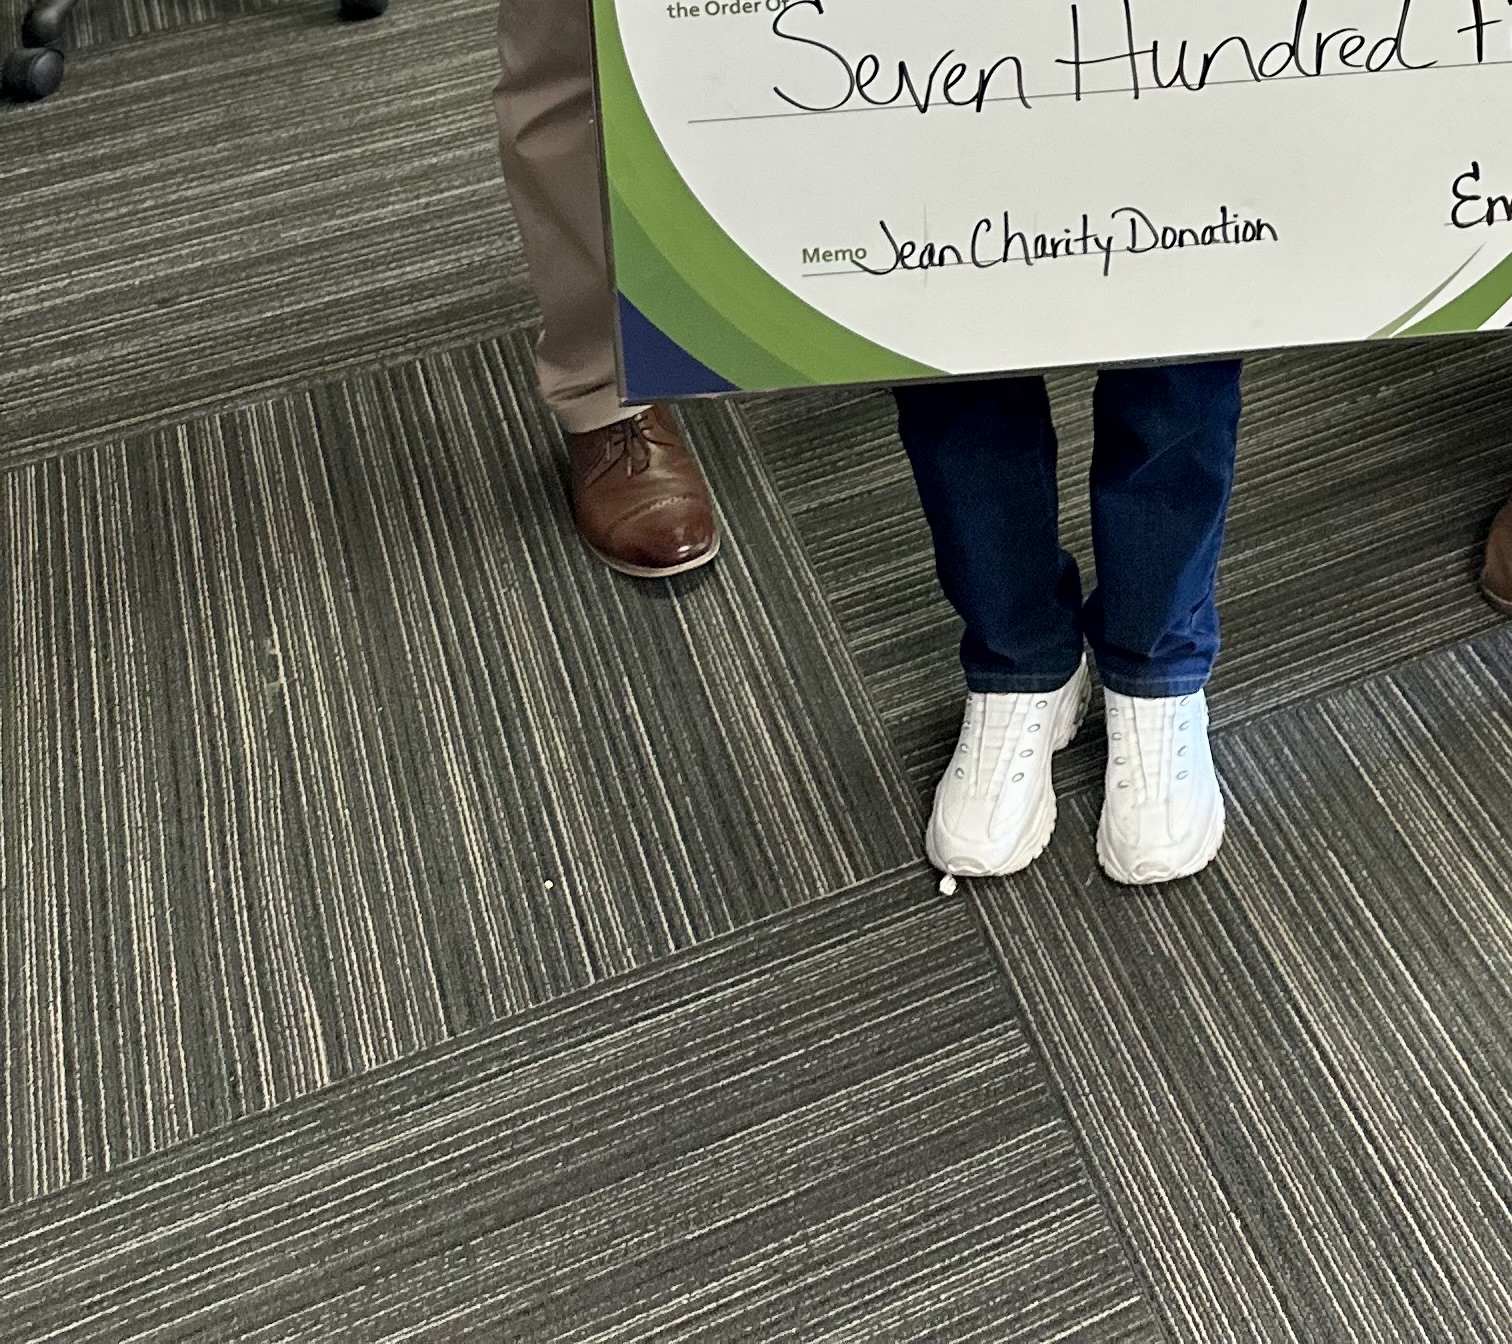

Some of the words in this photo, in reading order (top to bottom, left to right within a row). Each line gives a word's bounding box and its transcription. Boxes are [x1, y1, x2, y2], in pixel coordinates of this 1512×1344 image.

[666, 2, 700, 18] the
[850, 220, 964, 275] Jean
[970, 211, 1114, 277] Charity
[1110, 206, 1280, 254] Donation
[801, 245, 868, 264] Memo
